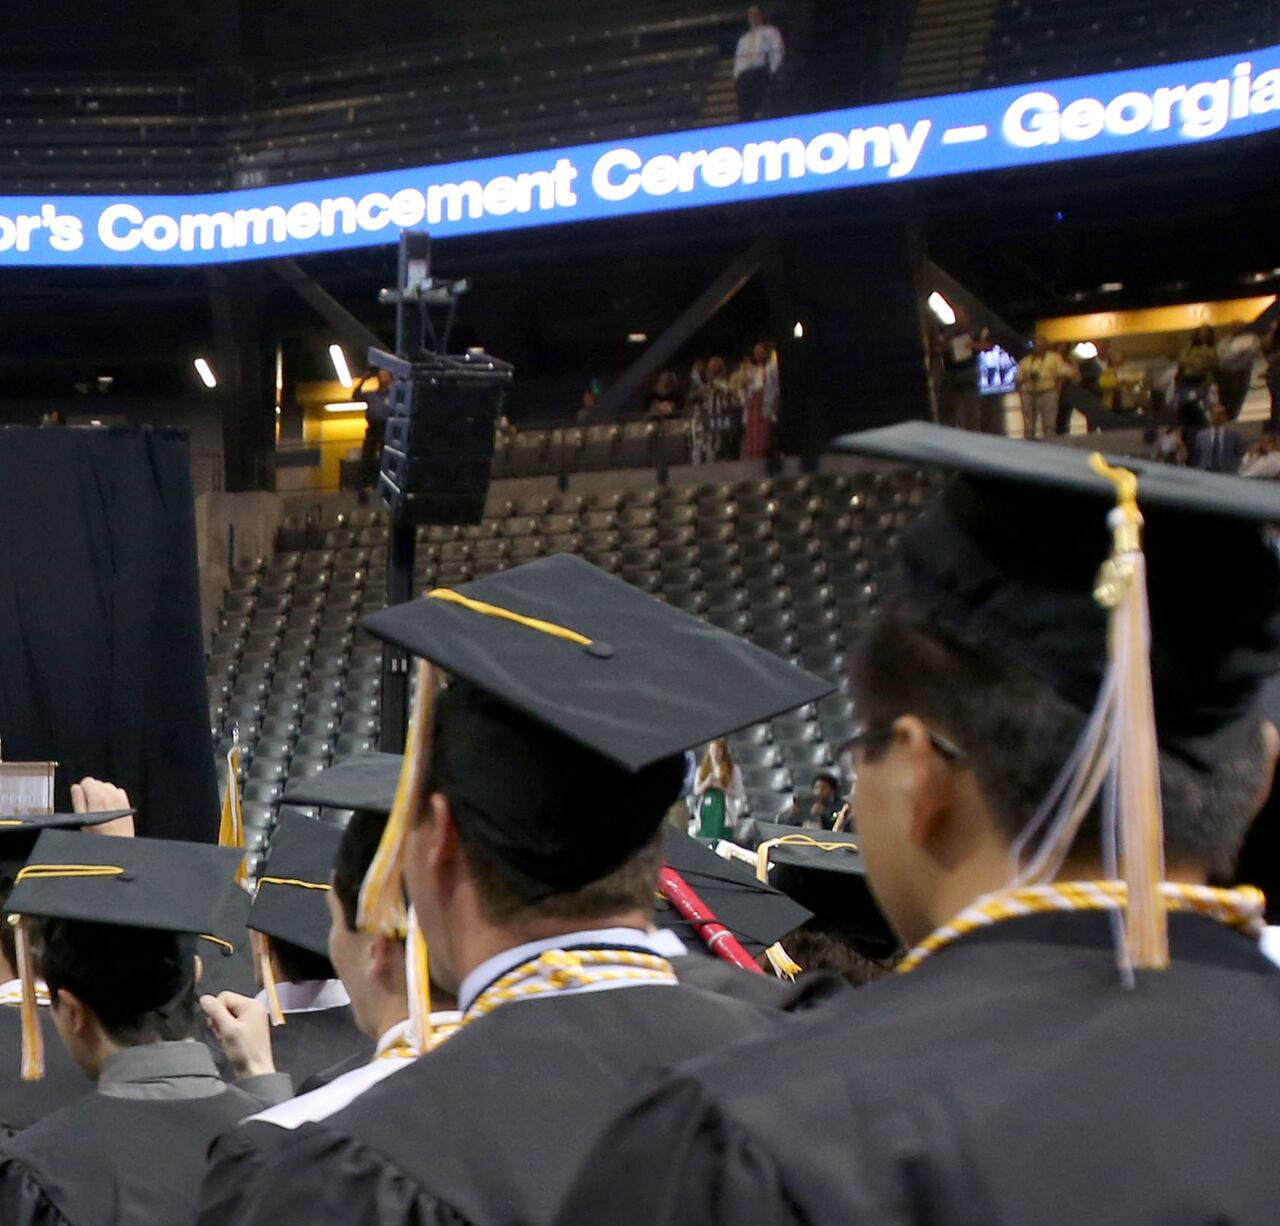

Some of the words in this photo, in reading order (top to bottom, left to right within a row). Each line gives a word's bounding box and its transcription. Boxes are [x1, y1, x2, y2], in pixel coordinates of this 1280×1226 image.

[97, 158, 578, 252] Commencement
[591, 119, 932, 201] Ceremony
[1002, 61, 1280, 149] Georgia
